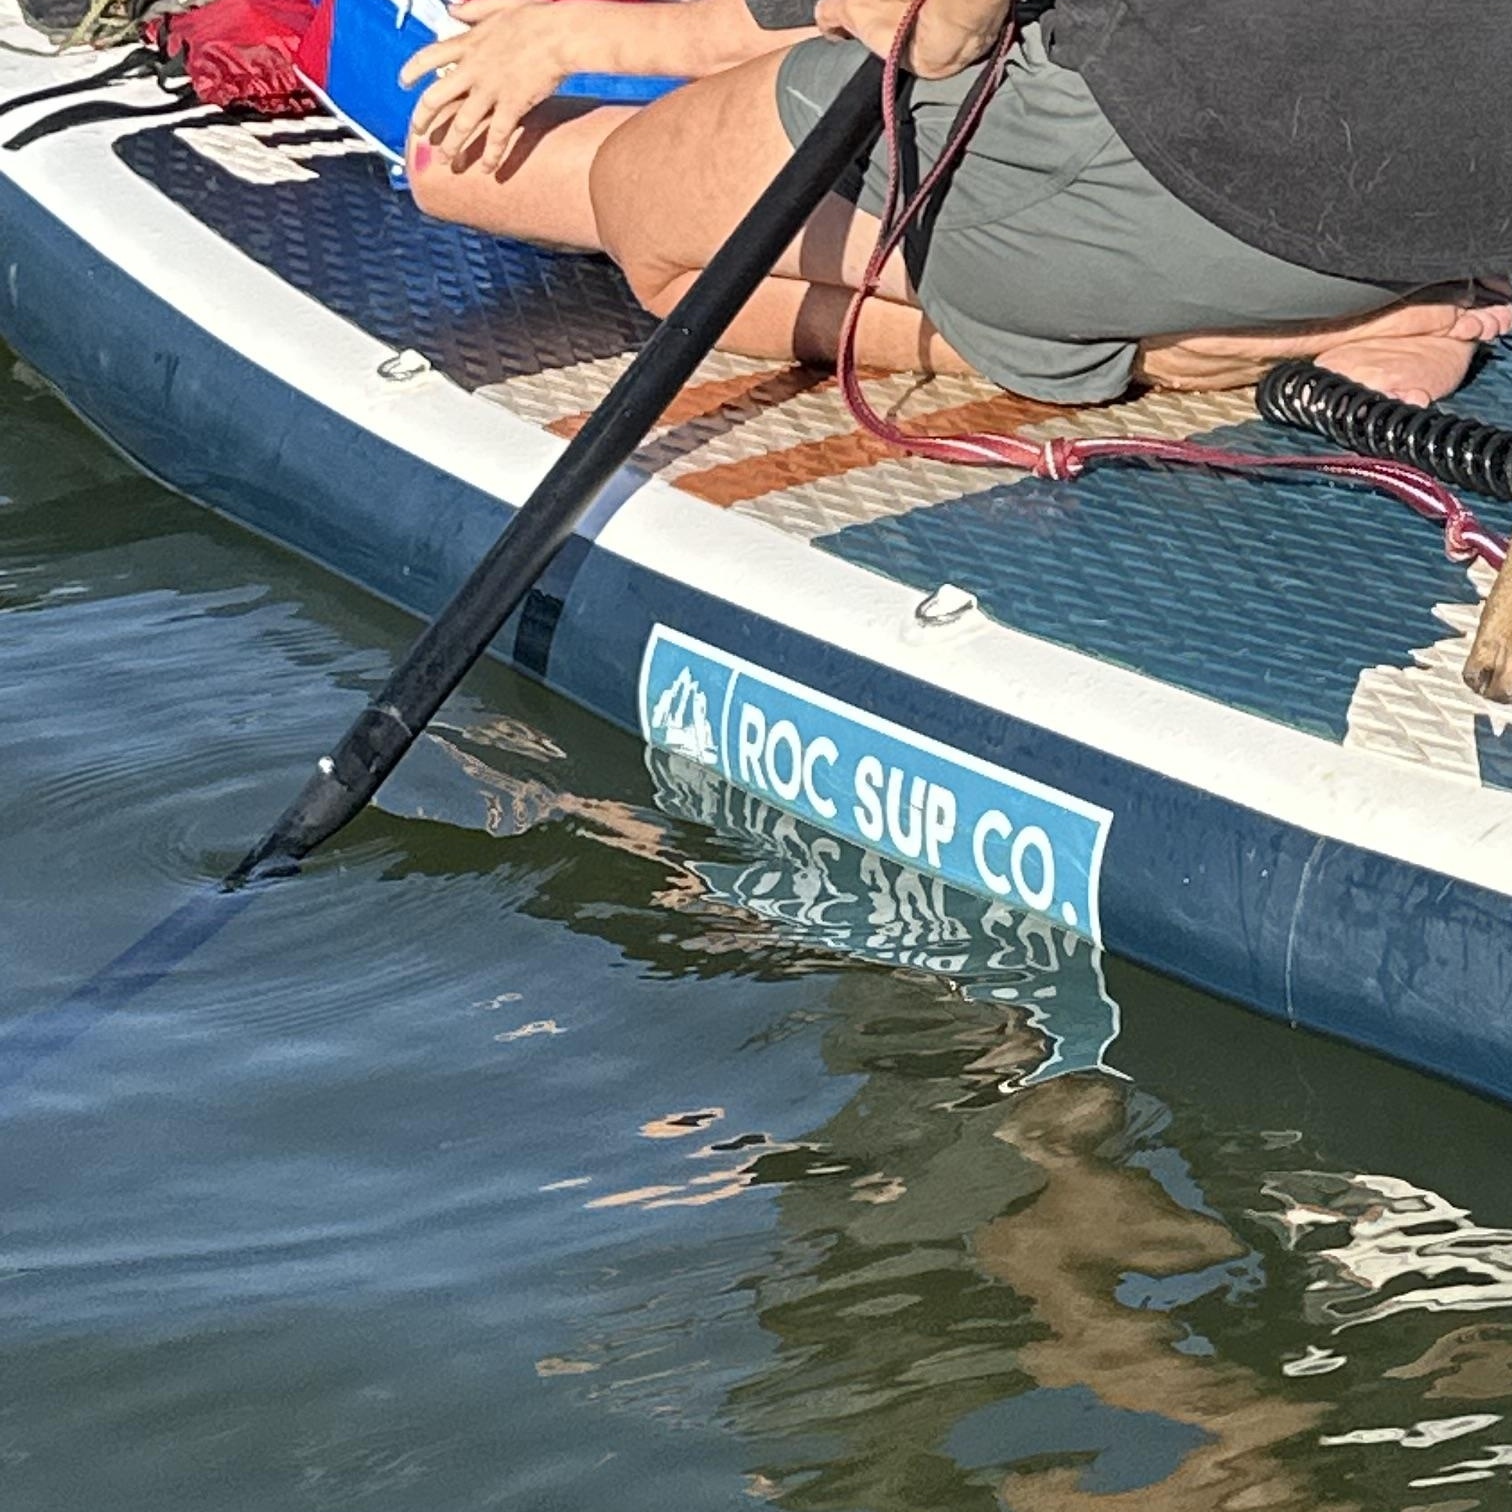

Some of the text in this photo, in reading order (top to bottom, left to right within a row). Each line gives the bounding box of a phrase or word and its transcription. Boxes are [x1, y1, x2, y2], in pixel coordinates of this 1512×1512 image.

[738, 704, 1078, 926] ROC SUP CO.
